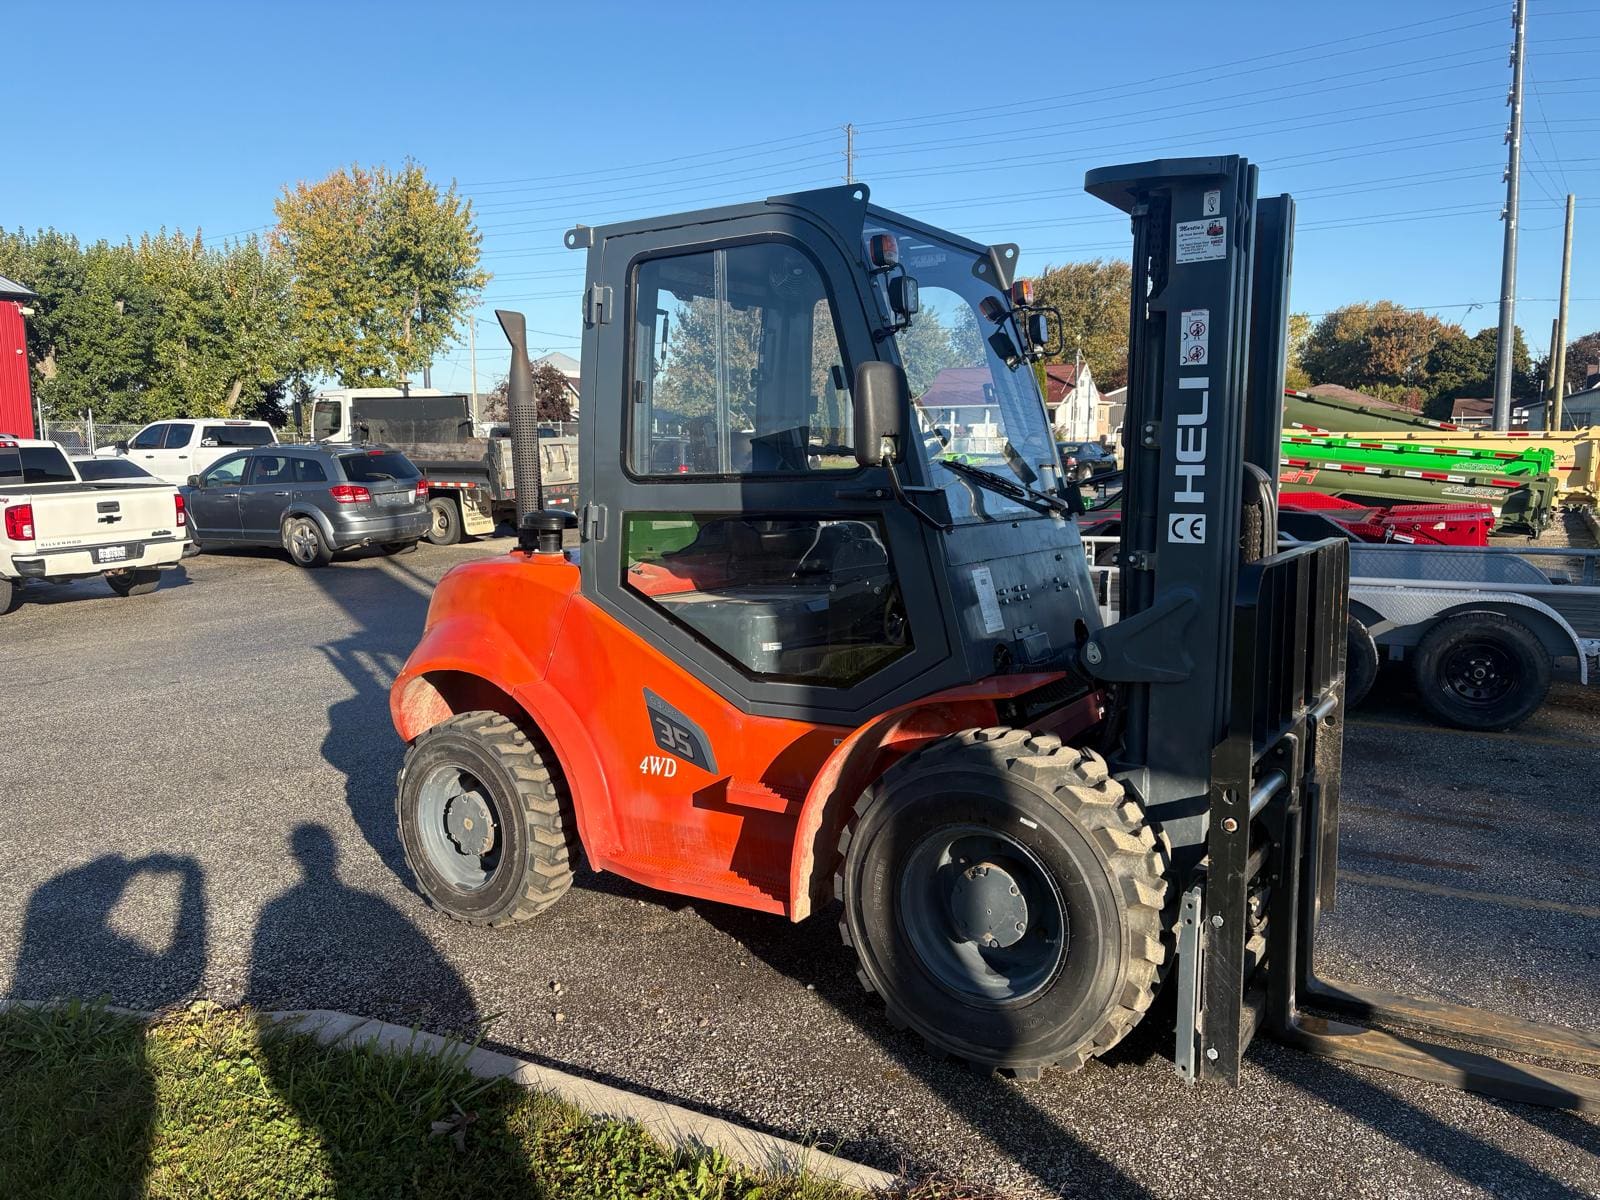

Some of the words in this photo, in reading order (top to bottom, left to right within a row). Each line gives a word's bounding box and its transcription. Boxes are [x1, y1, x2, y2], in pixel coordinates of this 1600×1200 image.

[1174, 376, 1210, 503] HELI
[1171, 517, 1203, 540] CE
[655, 717, 695, 759] 35
[639, 755, 677, 778] 4WD
